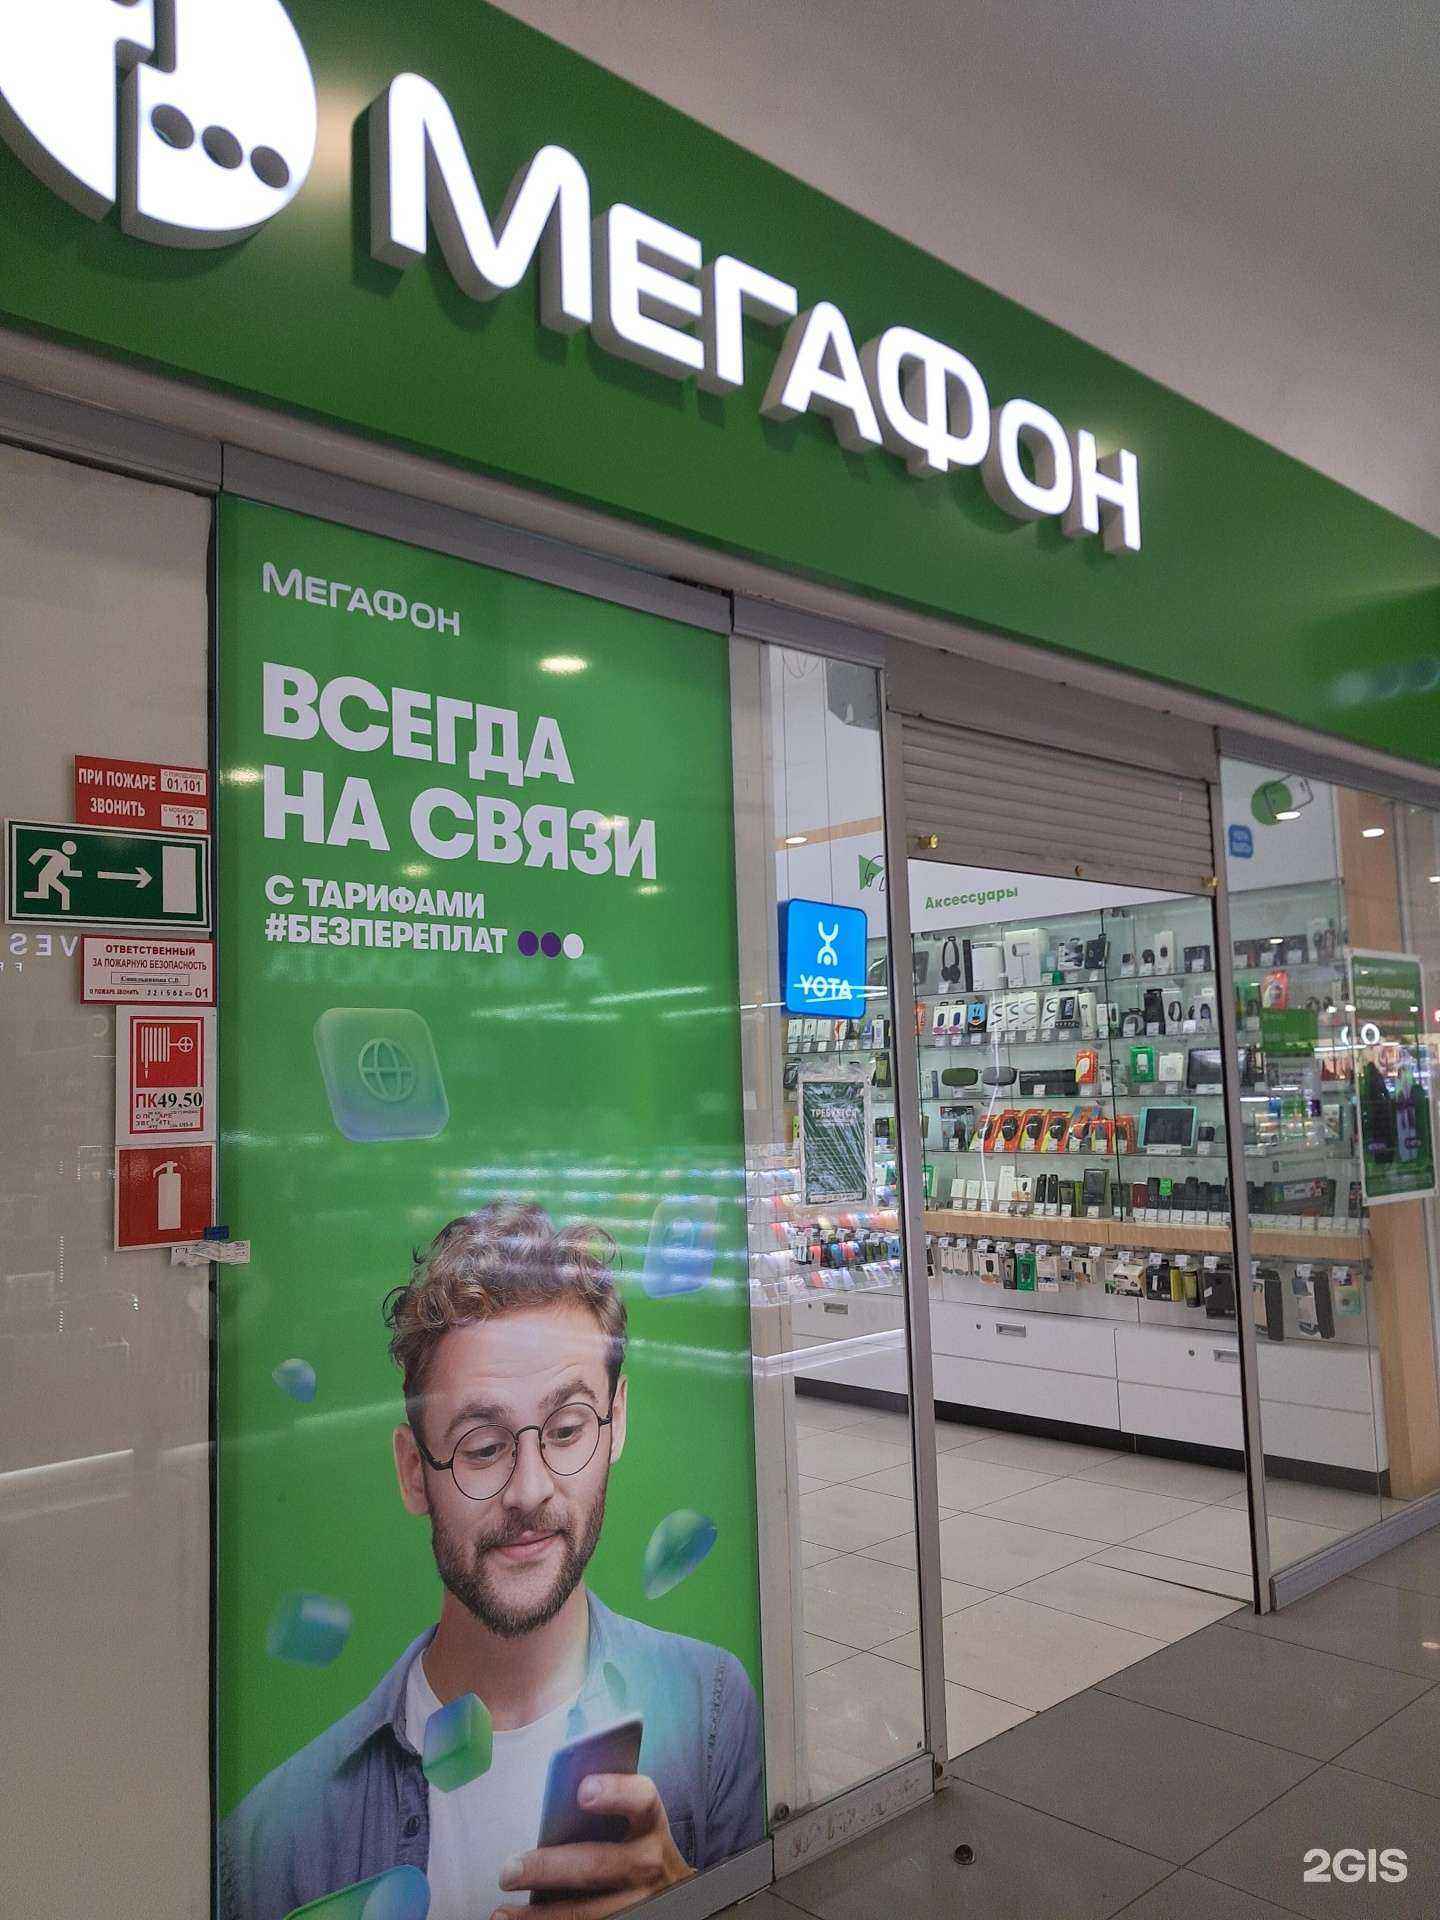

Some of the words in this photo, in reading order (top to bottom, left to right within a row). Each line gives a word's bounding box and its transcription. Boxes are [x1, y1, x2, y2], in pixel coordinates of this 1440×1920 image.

[263, 661, 575, 787] ВСЕГДА
[79, 768, 102, 786] ПРИ
[106, 771, 156, 791] ПОЖАРЕ
[90, 798, 146, 817] ЗВОНИТЬ
[176, 814, 194, 826] 112
[263, 764, 391, 851] НА
[410, 787, 657, 880] СВЯЗИ
[265, 874, 294, 905] С
[303, 878, 485, 920] ТАРИФАМИ
[925, 887, 1018, 909] Аксессуары
[264, 912, 508, 954] #БЕЗПЕРЕПЛАТ
[105, 945, 196, 956] ОТВЕТСТВЕННЫЙ
[92, 958, 102, 967] ЗА
[104, 958, 148, 969] ПОЖАРНУЮ
[149, 961, 207, 971] БЕЗОПАСНОСТЬ
[195, 987, 208, 998] 01
[800, 974, 853, 1000] YOTA
